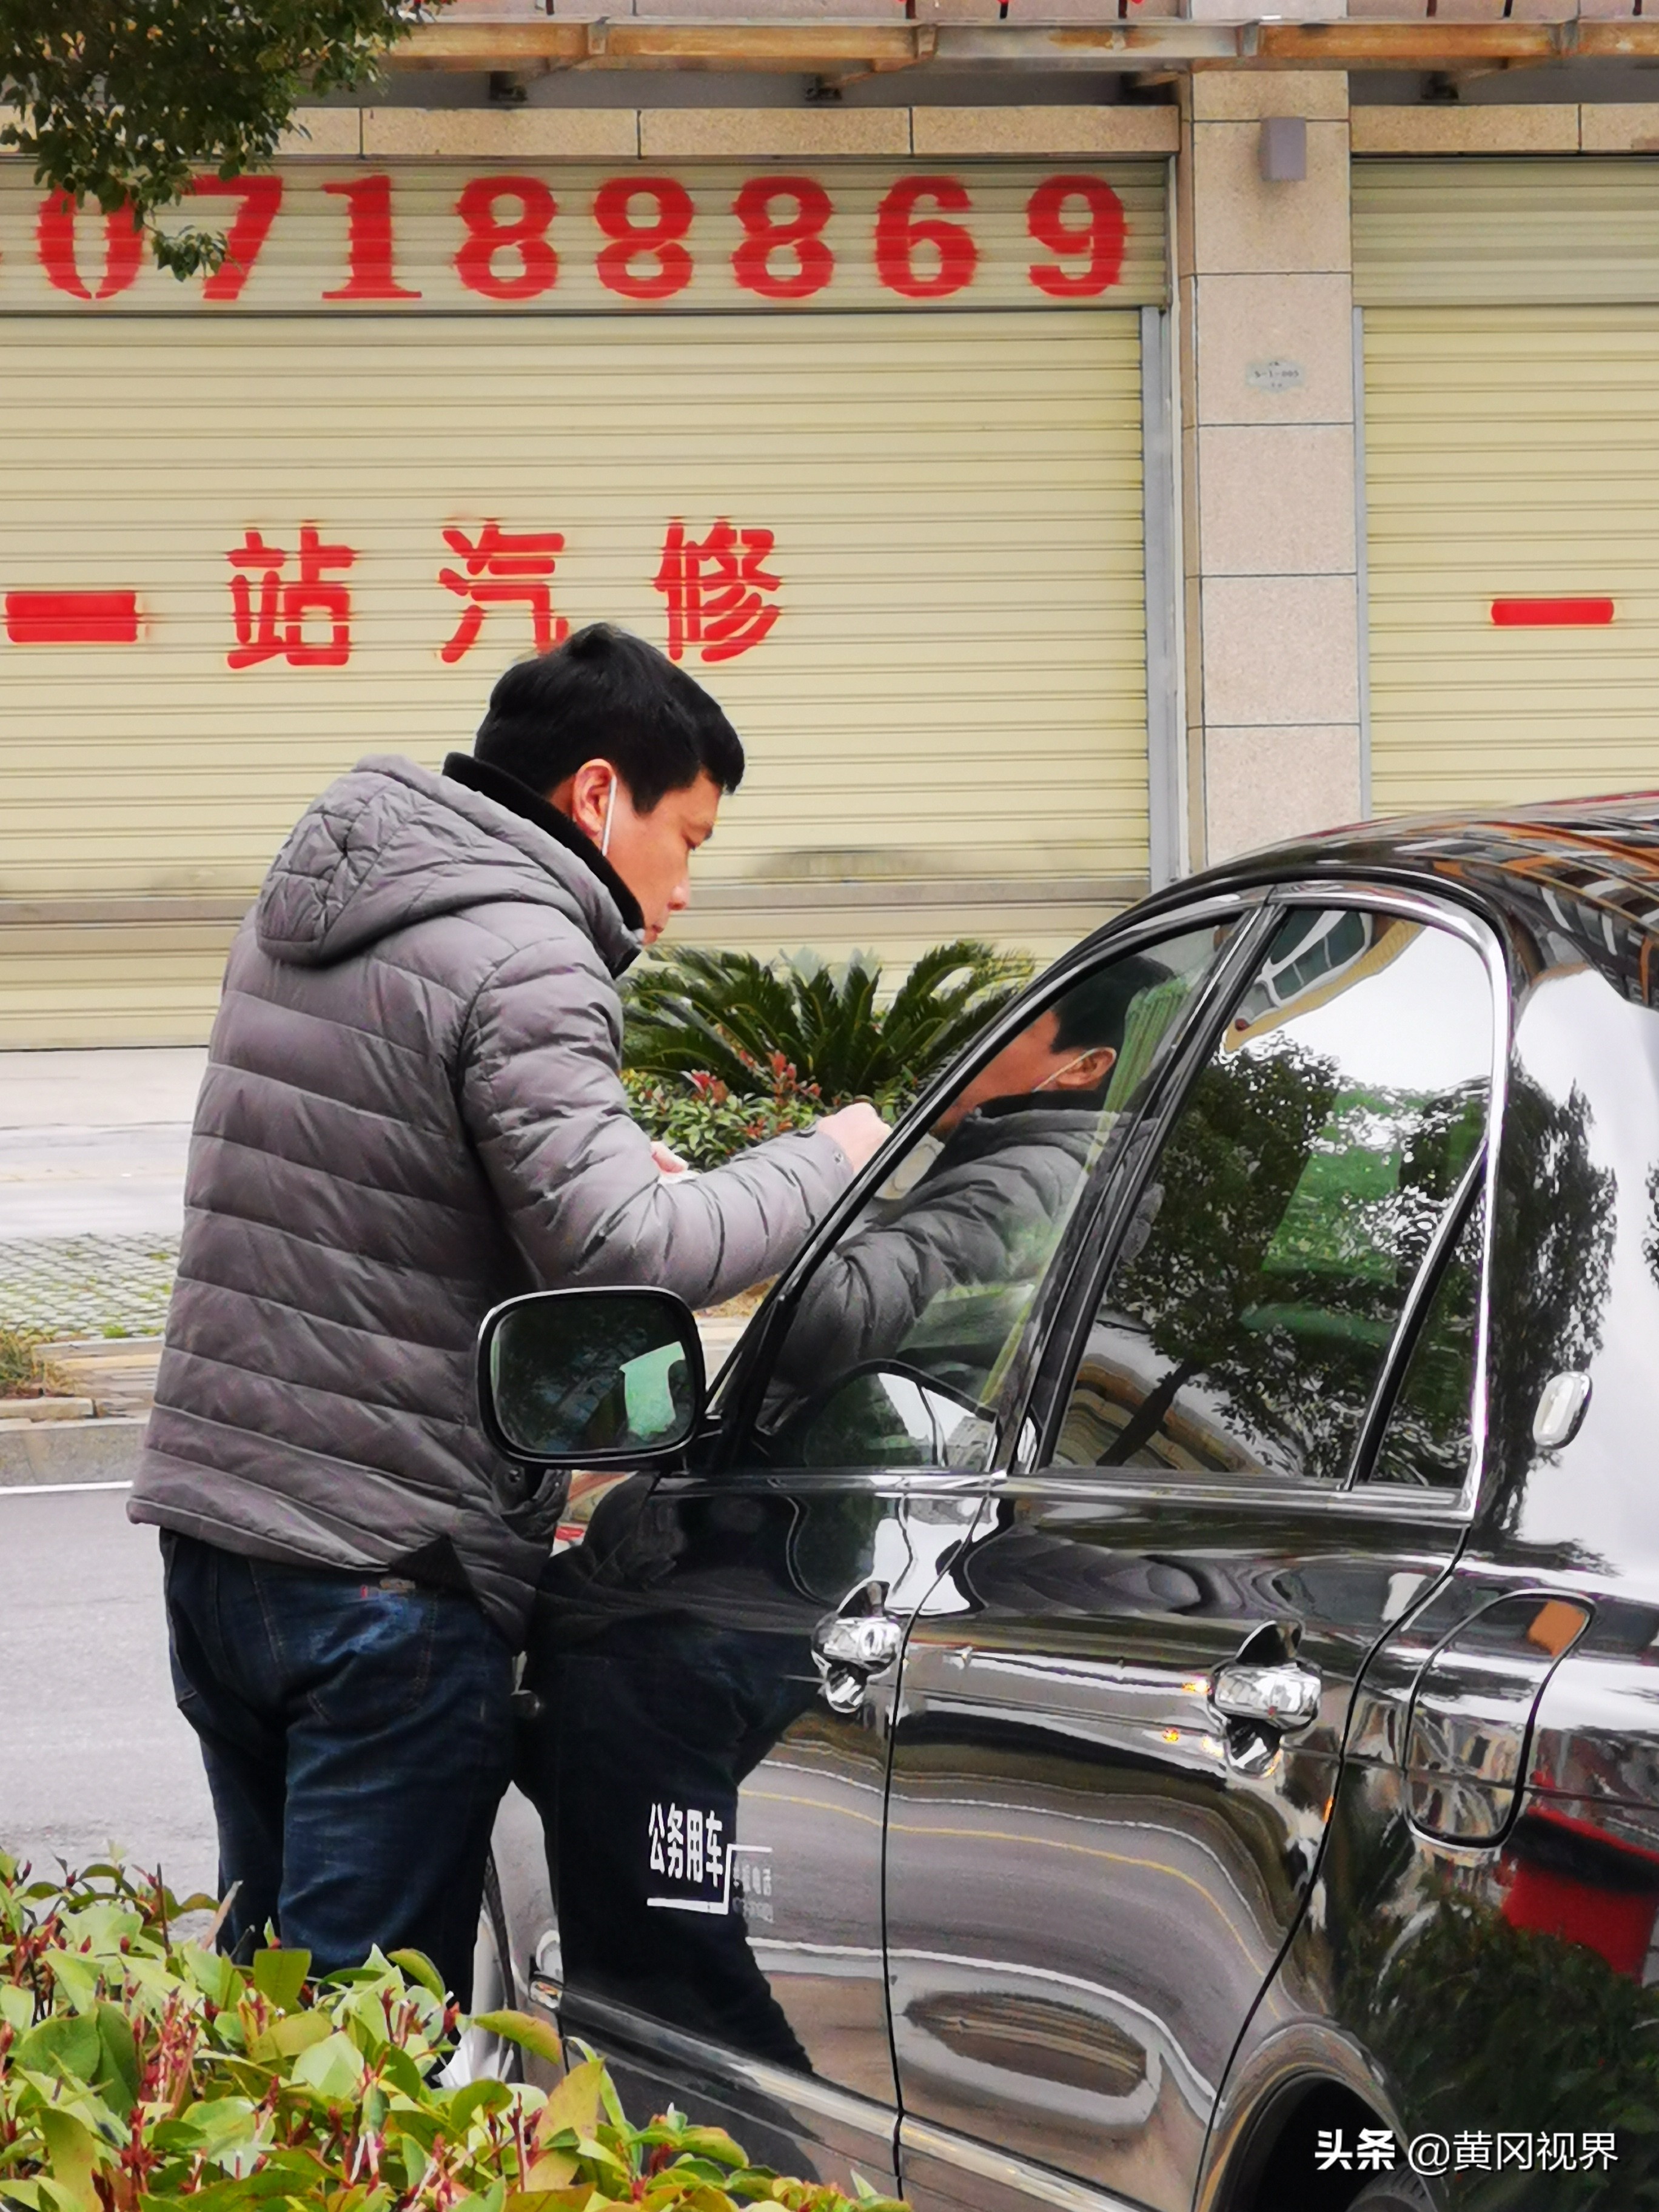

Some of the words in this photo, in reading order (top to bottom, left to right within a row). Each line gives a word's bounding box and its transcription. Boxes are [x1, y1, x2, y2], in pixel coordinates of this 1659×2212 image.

[5, 517, 781, 669] 一站汽修
[648, 1802, 723, 1888] 公务用车
